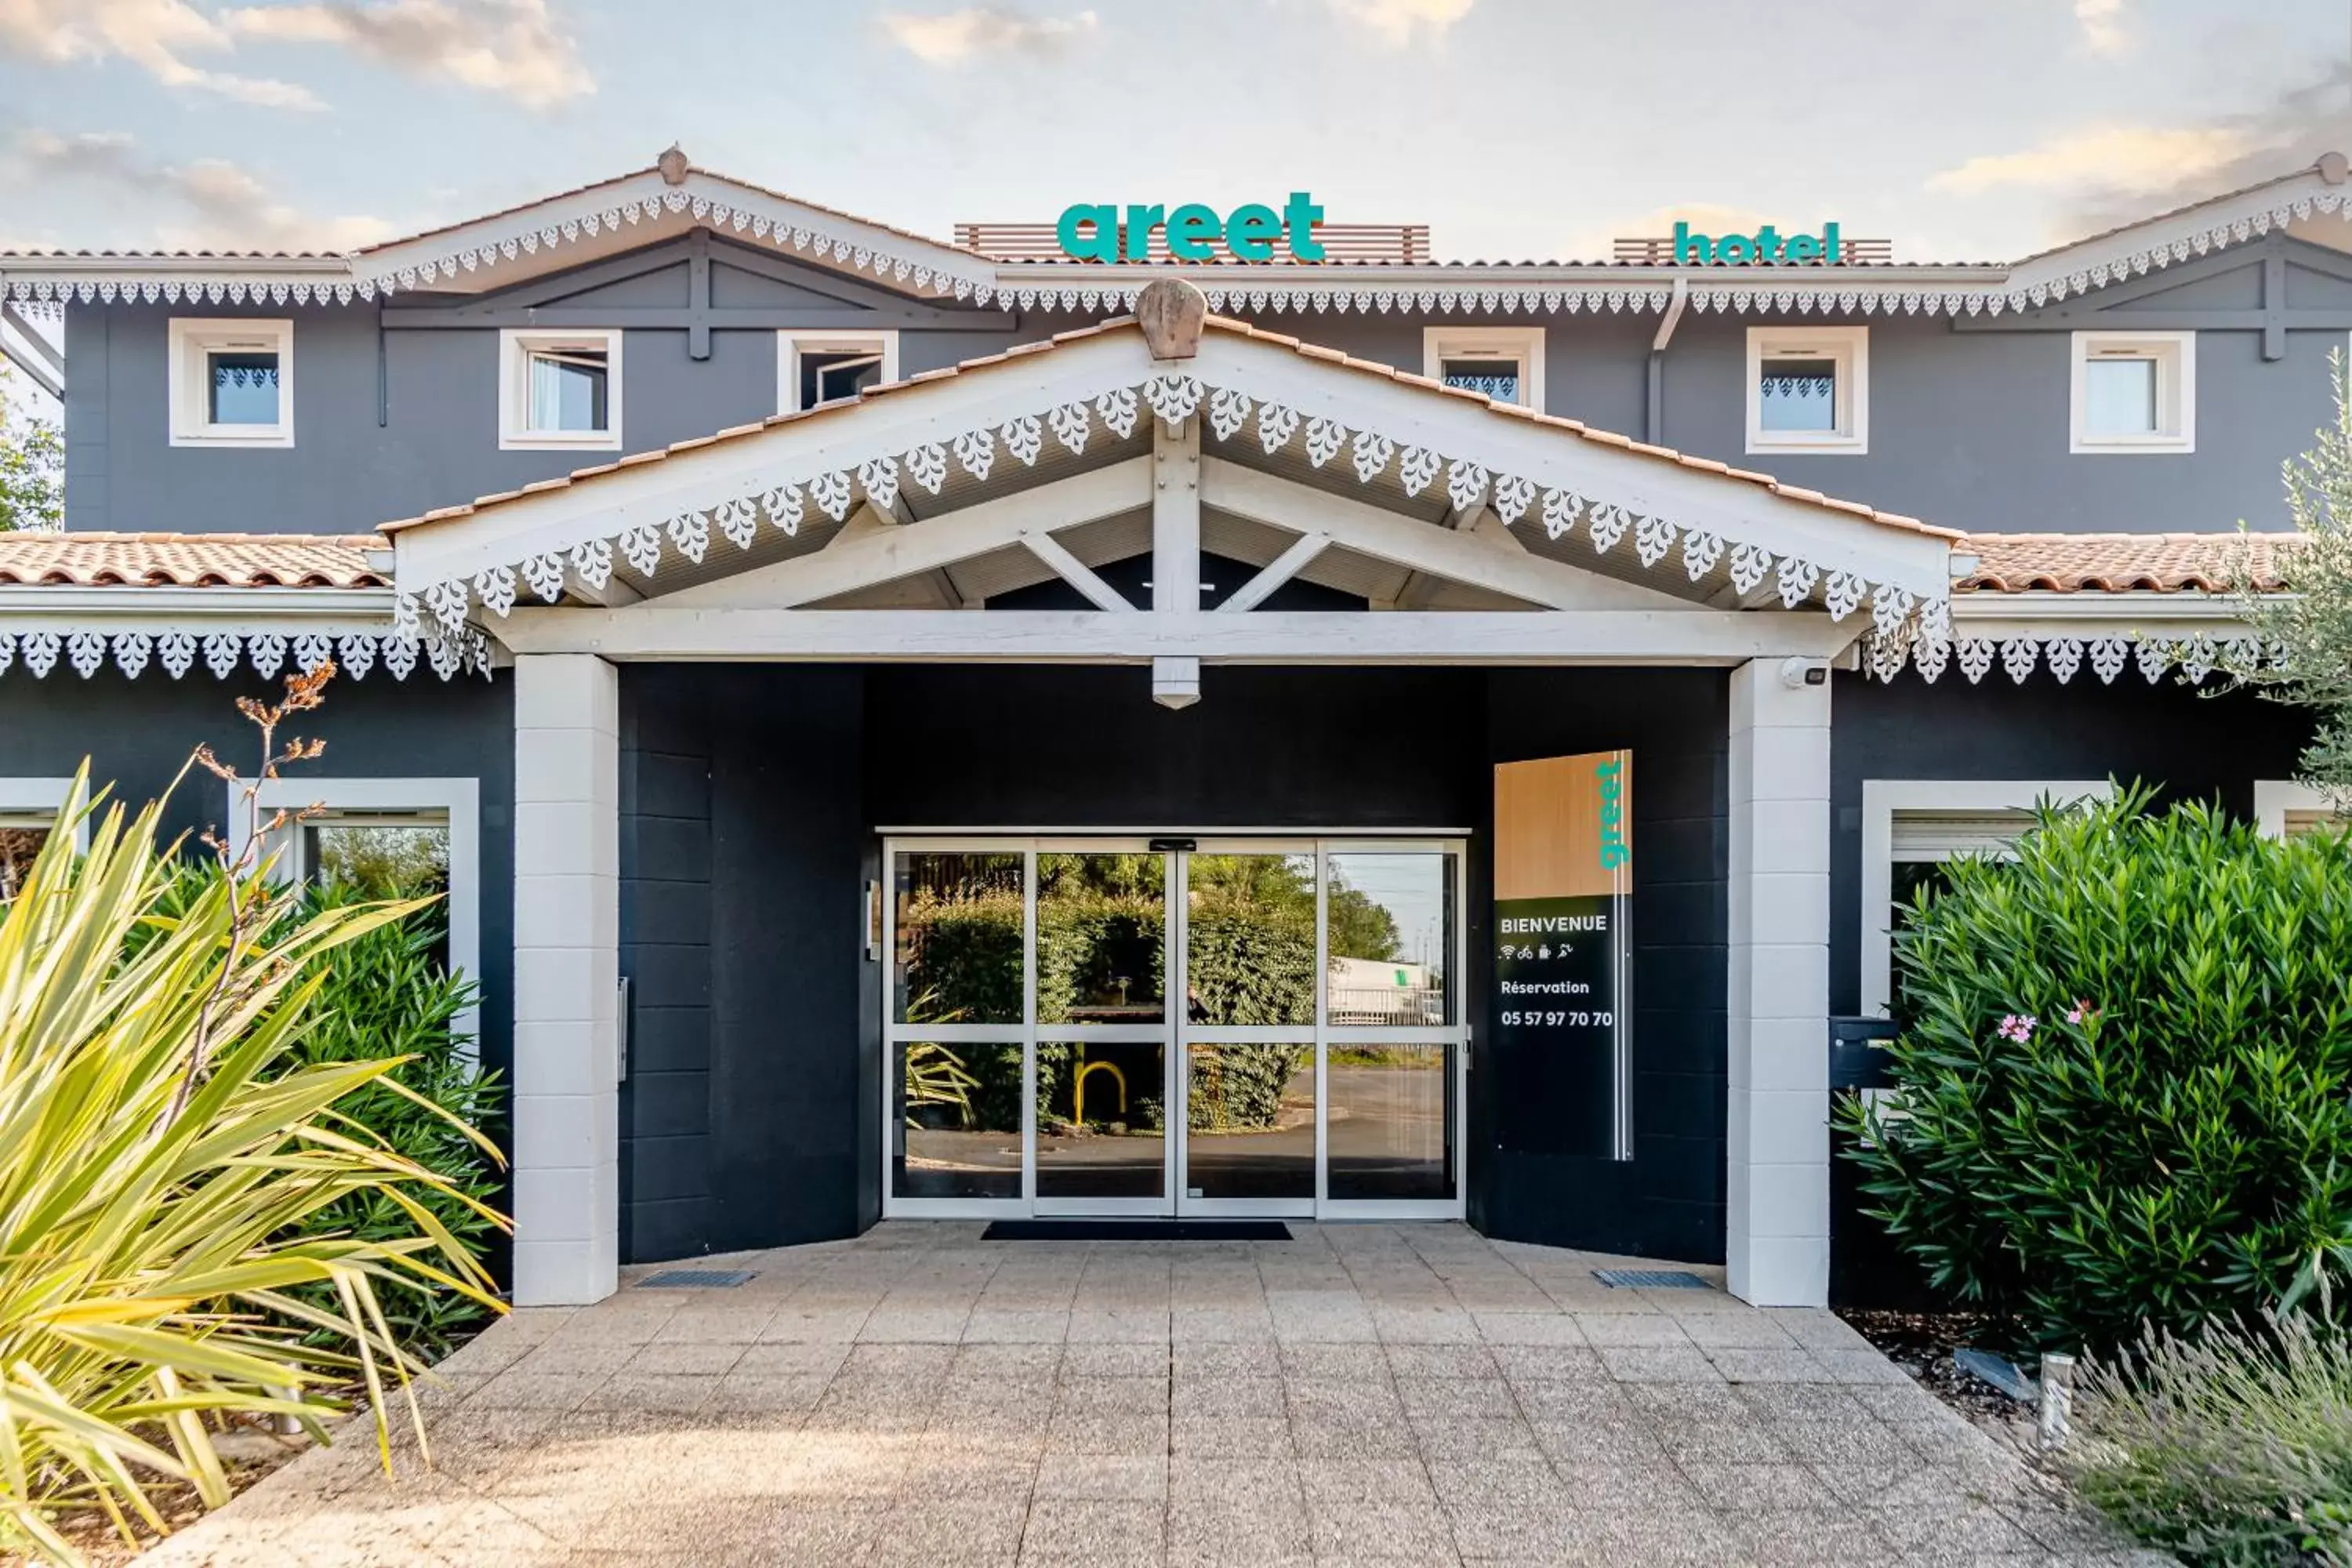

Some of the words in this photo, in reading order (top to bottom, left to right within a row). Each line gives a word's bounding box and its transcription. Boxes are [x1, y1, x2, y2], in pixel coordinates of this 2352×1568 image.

[1057, 192, 1326, 263] greet
[1673, 222, 1839, 263] hotel
[1596, 760, 1630, 869] greet
[1501, 915, 1606, 933] BIENVENUE
[1501, 981, 1590, 994] Réservation
[1501, 1011, 1521, 1025] 05
[1525, 1011, 1543, 1025] 57
[1546, 1011, 1566, 1025] 97
[1569, 1011, 1589, 1026] 70
[1592, 1011, 1613, 1026] 70
